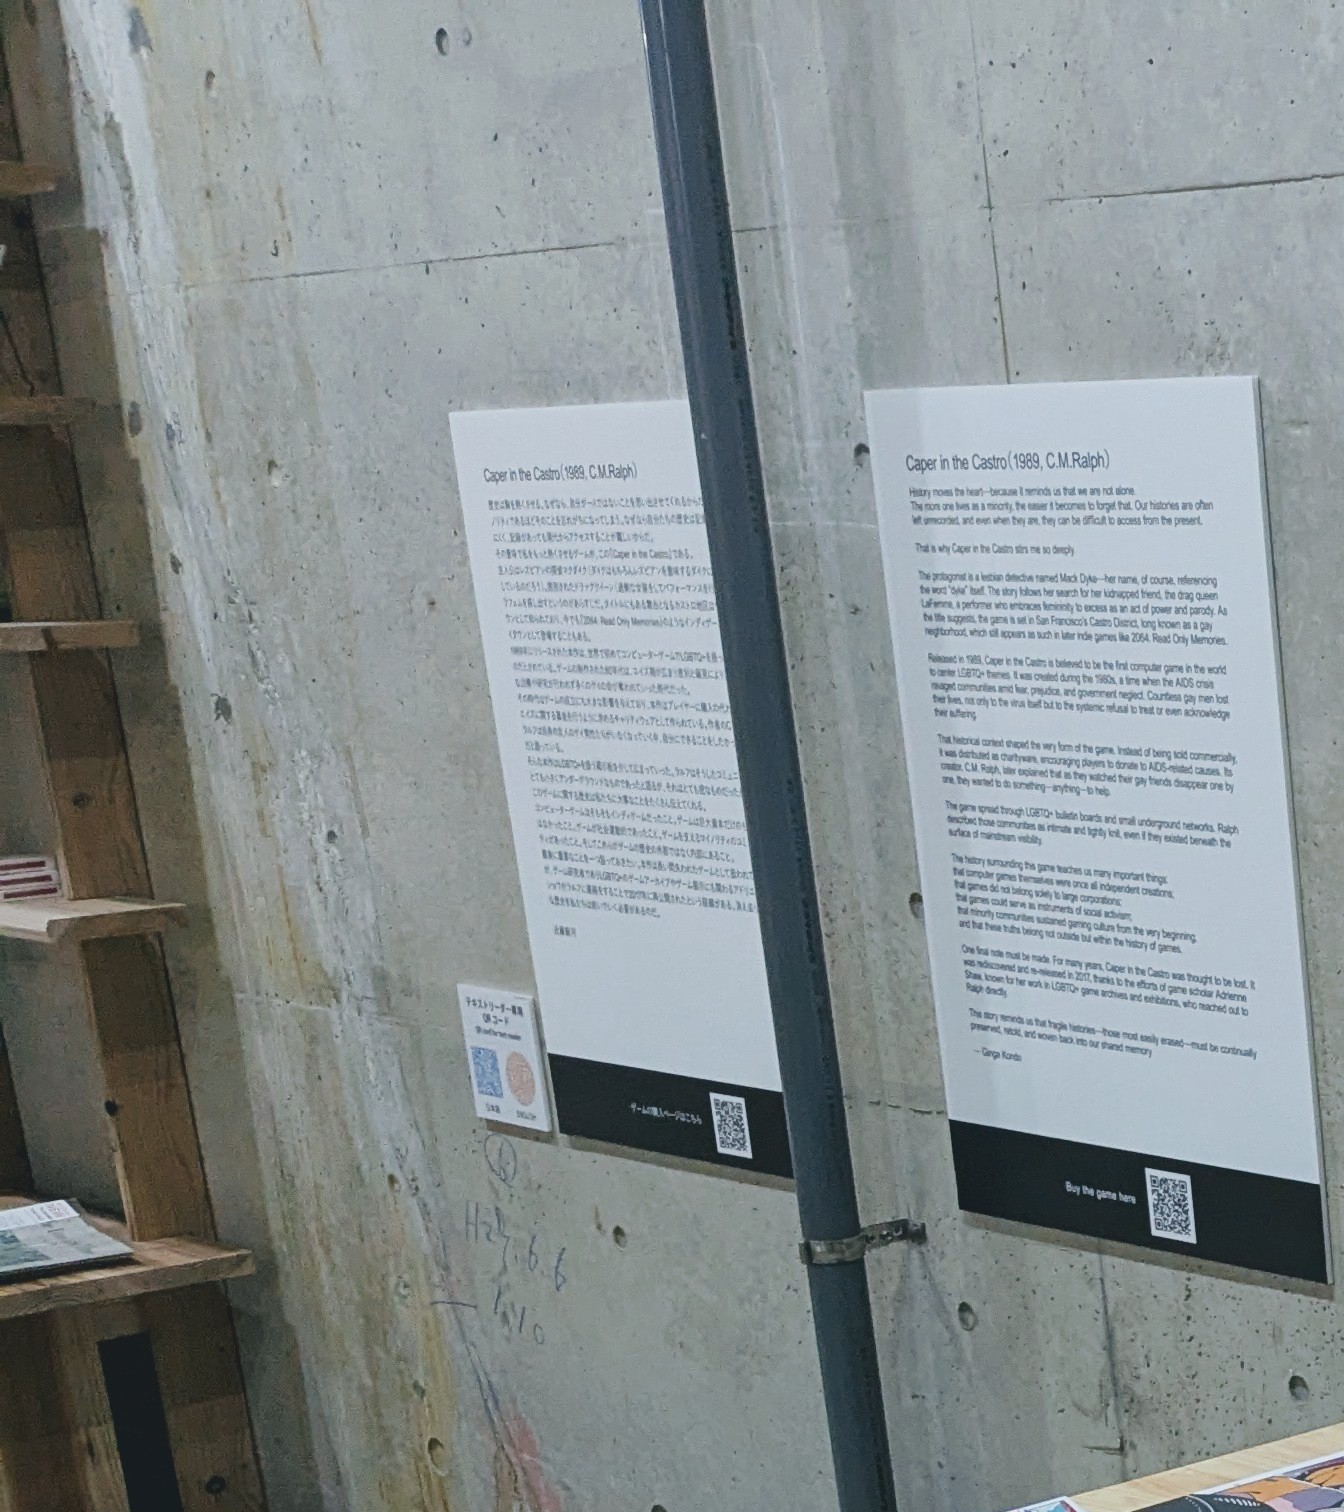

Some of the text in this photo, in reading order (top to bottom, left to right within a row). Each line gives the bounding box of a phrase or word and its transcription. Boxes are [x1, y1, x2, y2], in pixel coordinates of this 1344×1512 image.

[1065, 1180, 1137, 1205] Buy the game here
